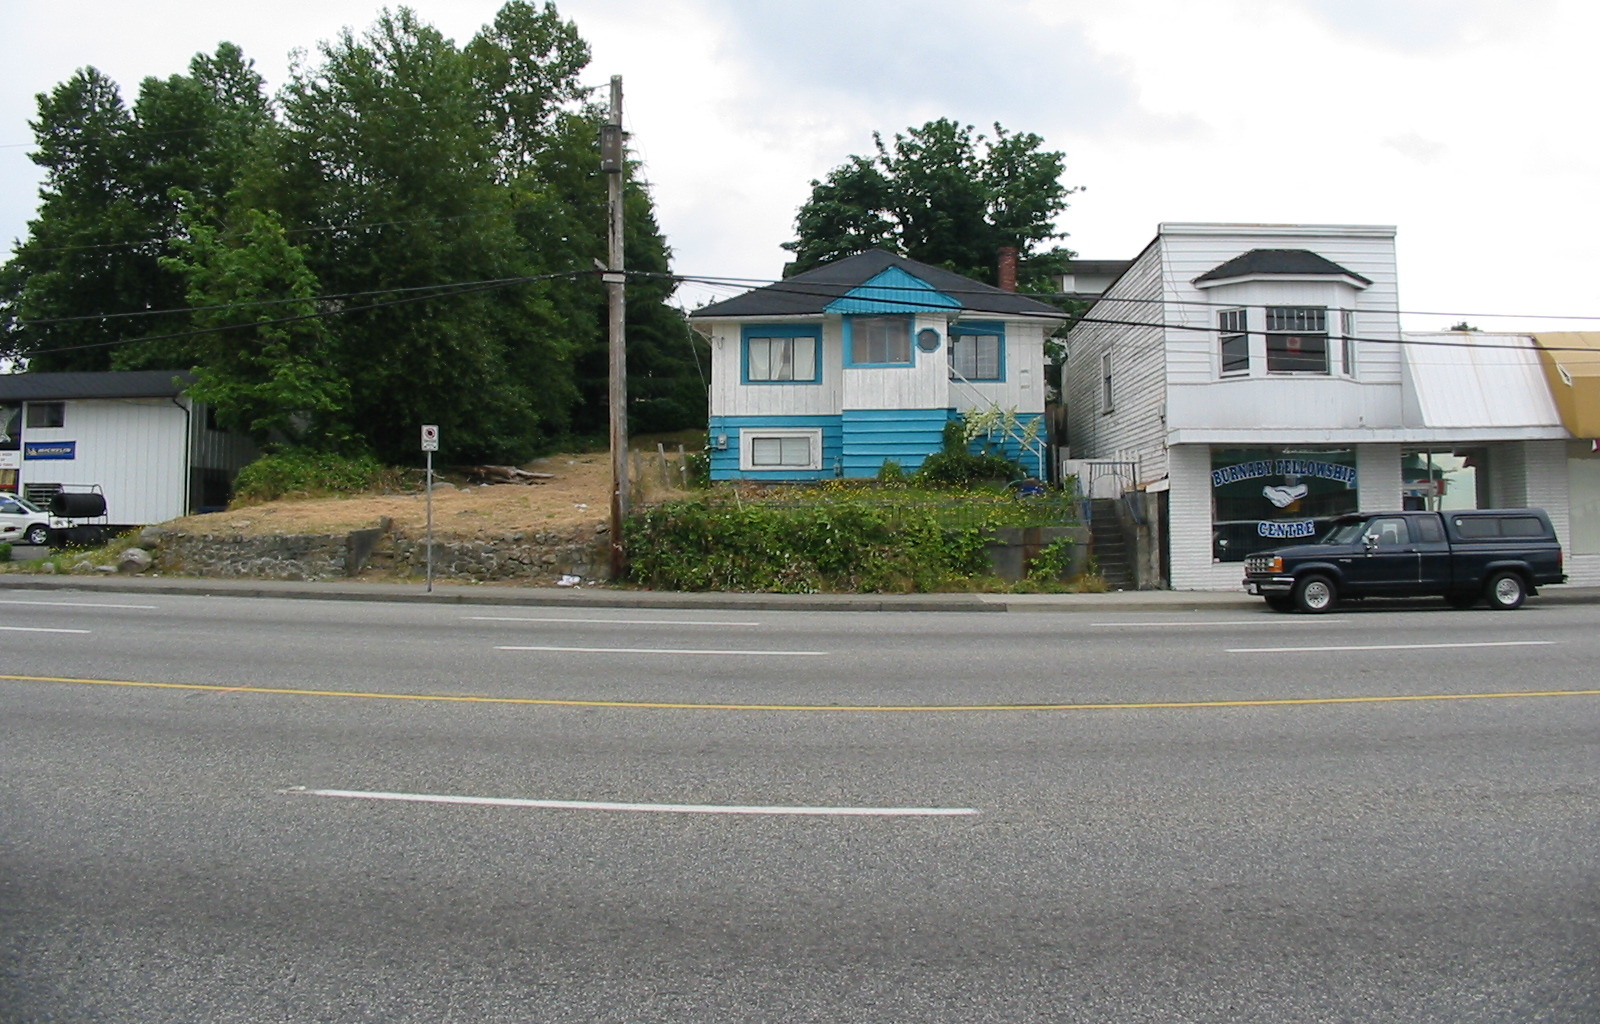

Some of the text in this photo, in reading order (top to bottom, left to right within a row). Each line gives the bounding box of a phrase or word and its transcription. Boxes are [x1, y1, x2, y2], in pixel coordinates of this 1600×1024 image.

[1211, 459, 1357, 487] BURNABY FELLOWSHIP
[1258, 520, 1315, 538] CENTRE
